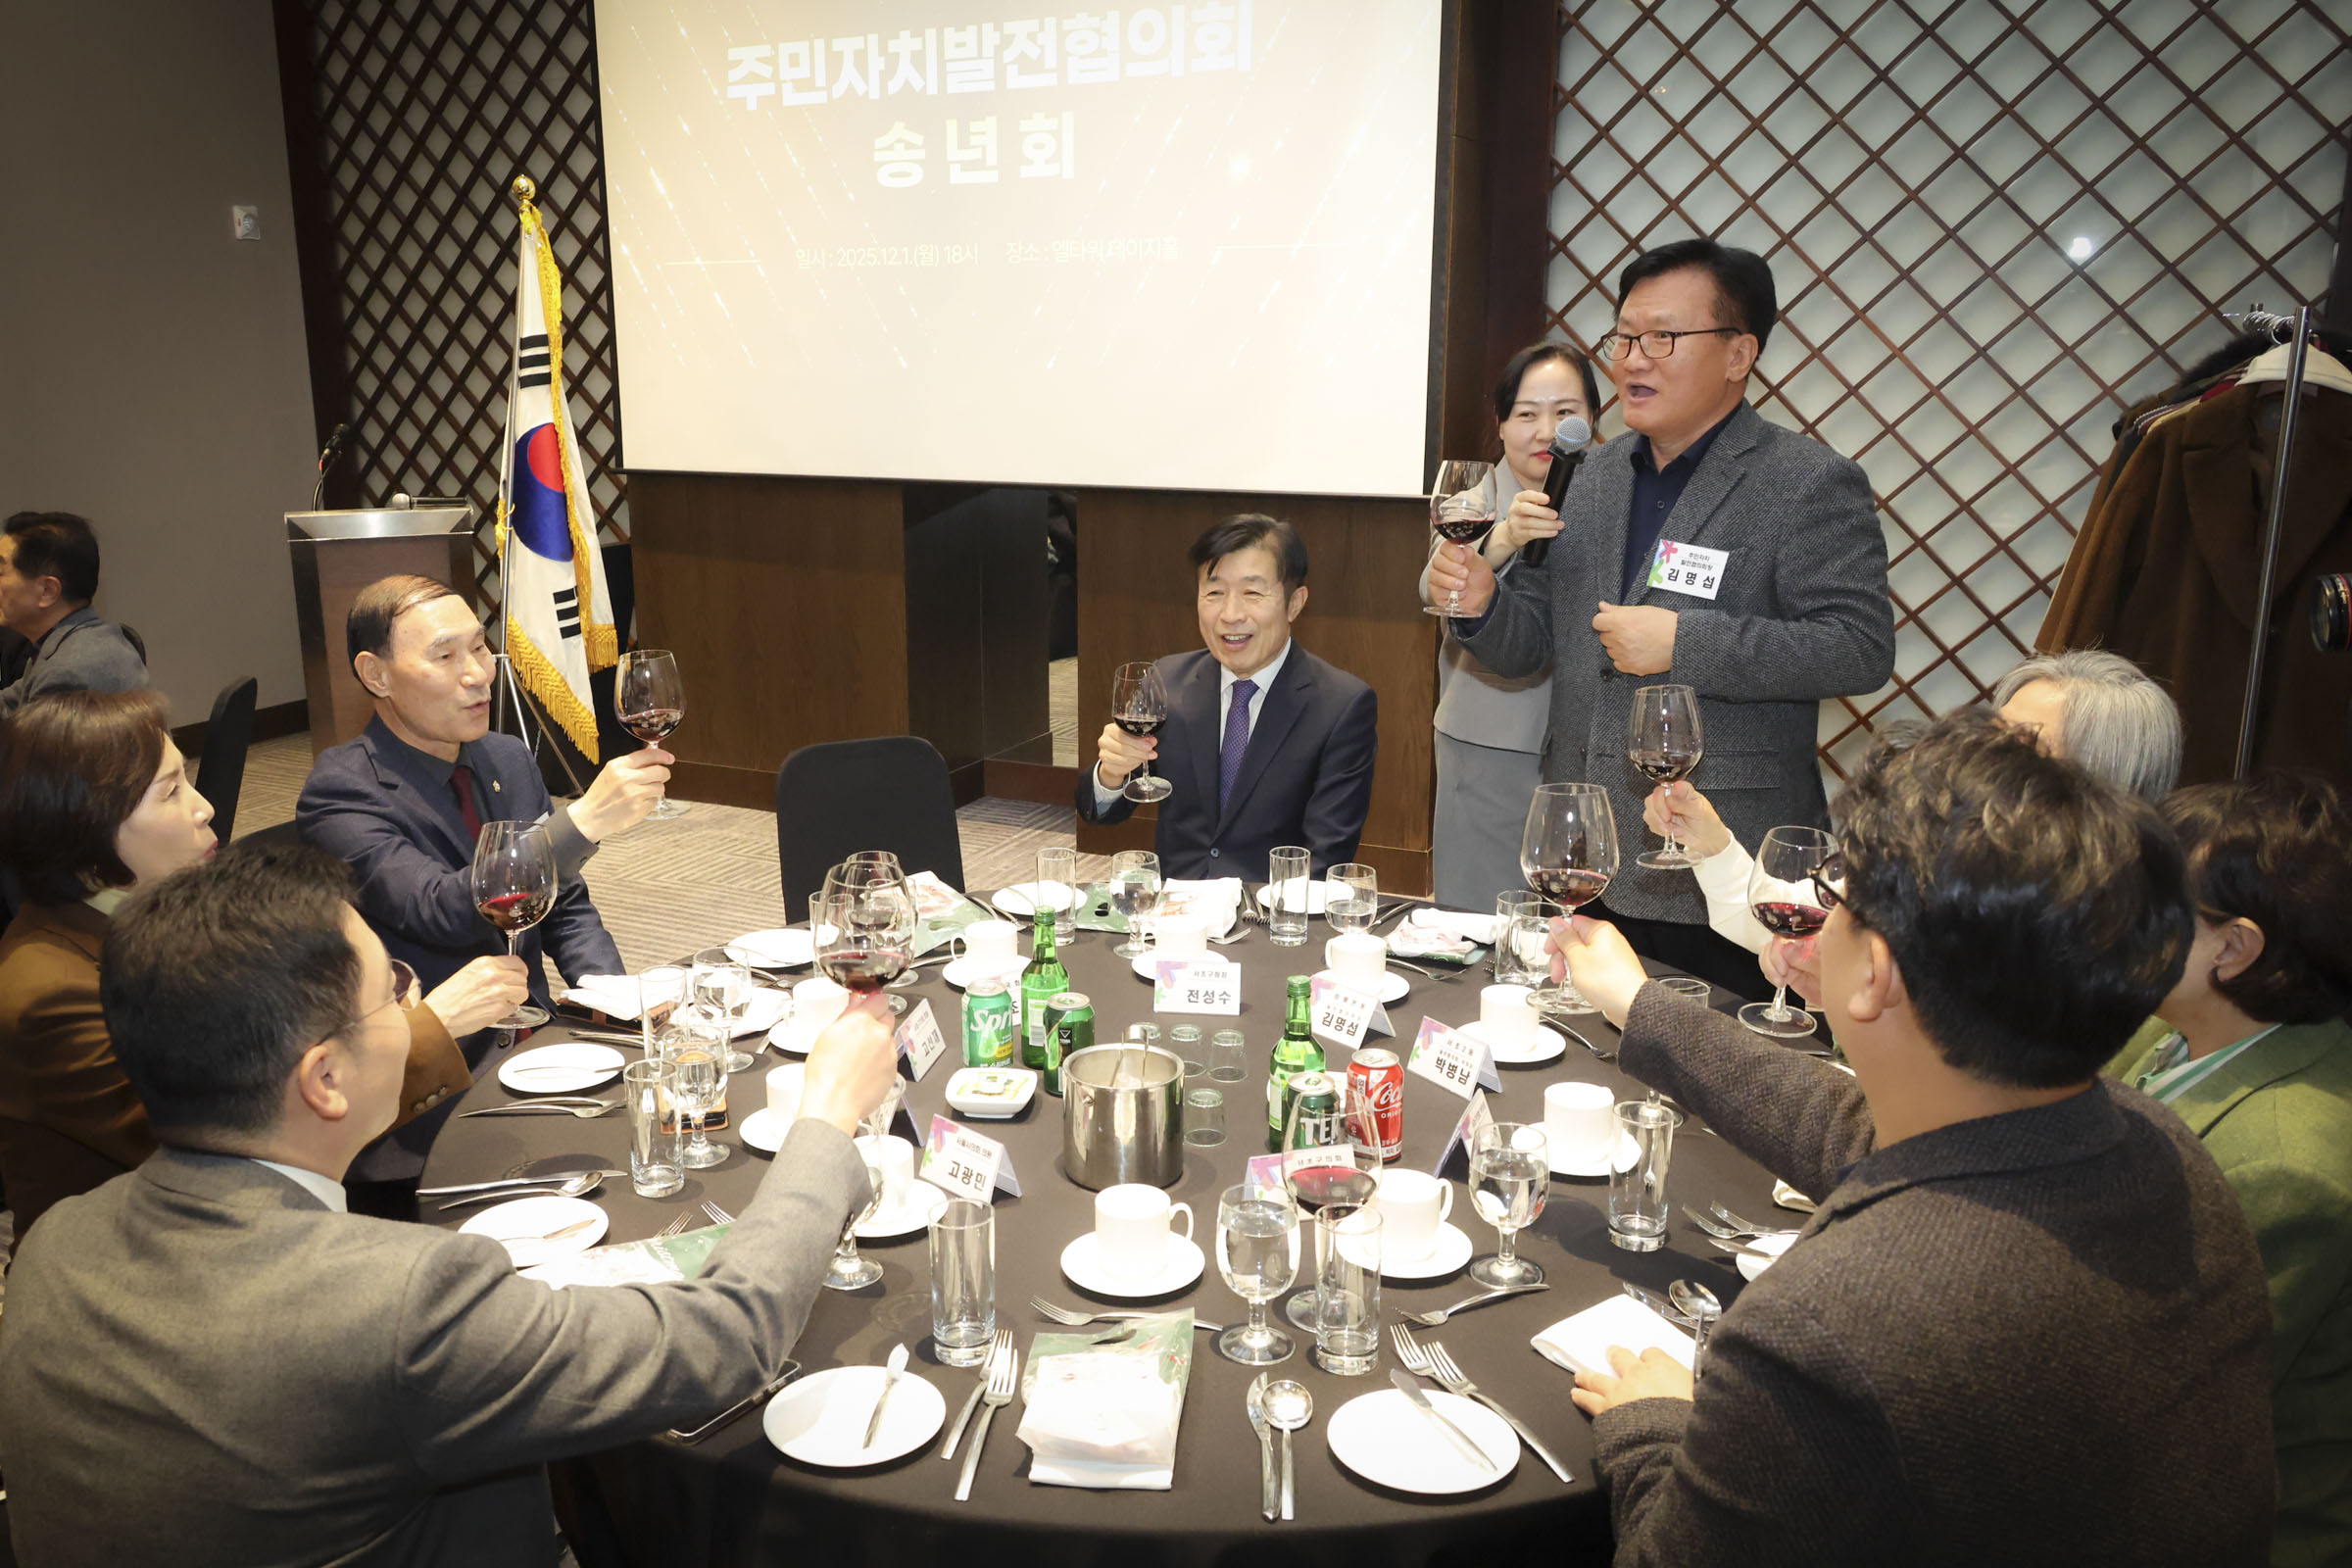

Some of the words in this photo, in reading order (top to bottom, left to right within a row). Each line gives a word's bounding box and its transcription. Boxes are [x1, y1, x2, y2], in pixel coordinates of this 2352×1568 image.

[725, 0, 1254, 111] 주민자치발전협의회
[944, 242, 979, 266] 18시
[1667, 567, 1716, 590] 김명섭
[1187, 989, 1232, 1004] 전성수
[1322, 1011, 1359, 1037] 김명섭
[1435, 1056, 1471, 1086] 박병남
[948, 1160, 987, 1193] 고광민
